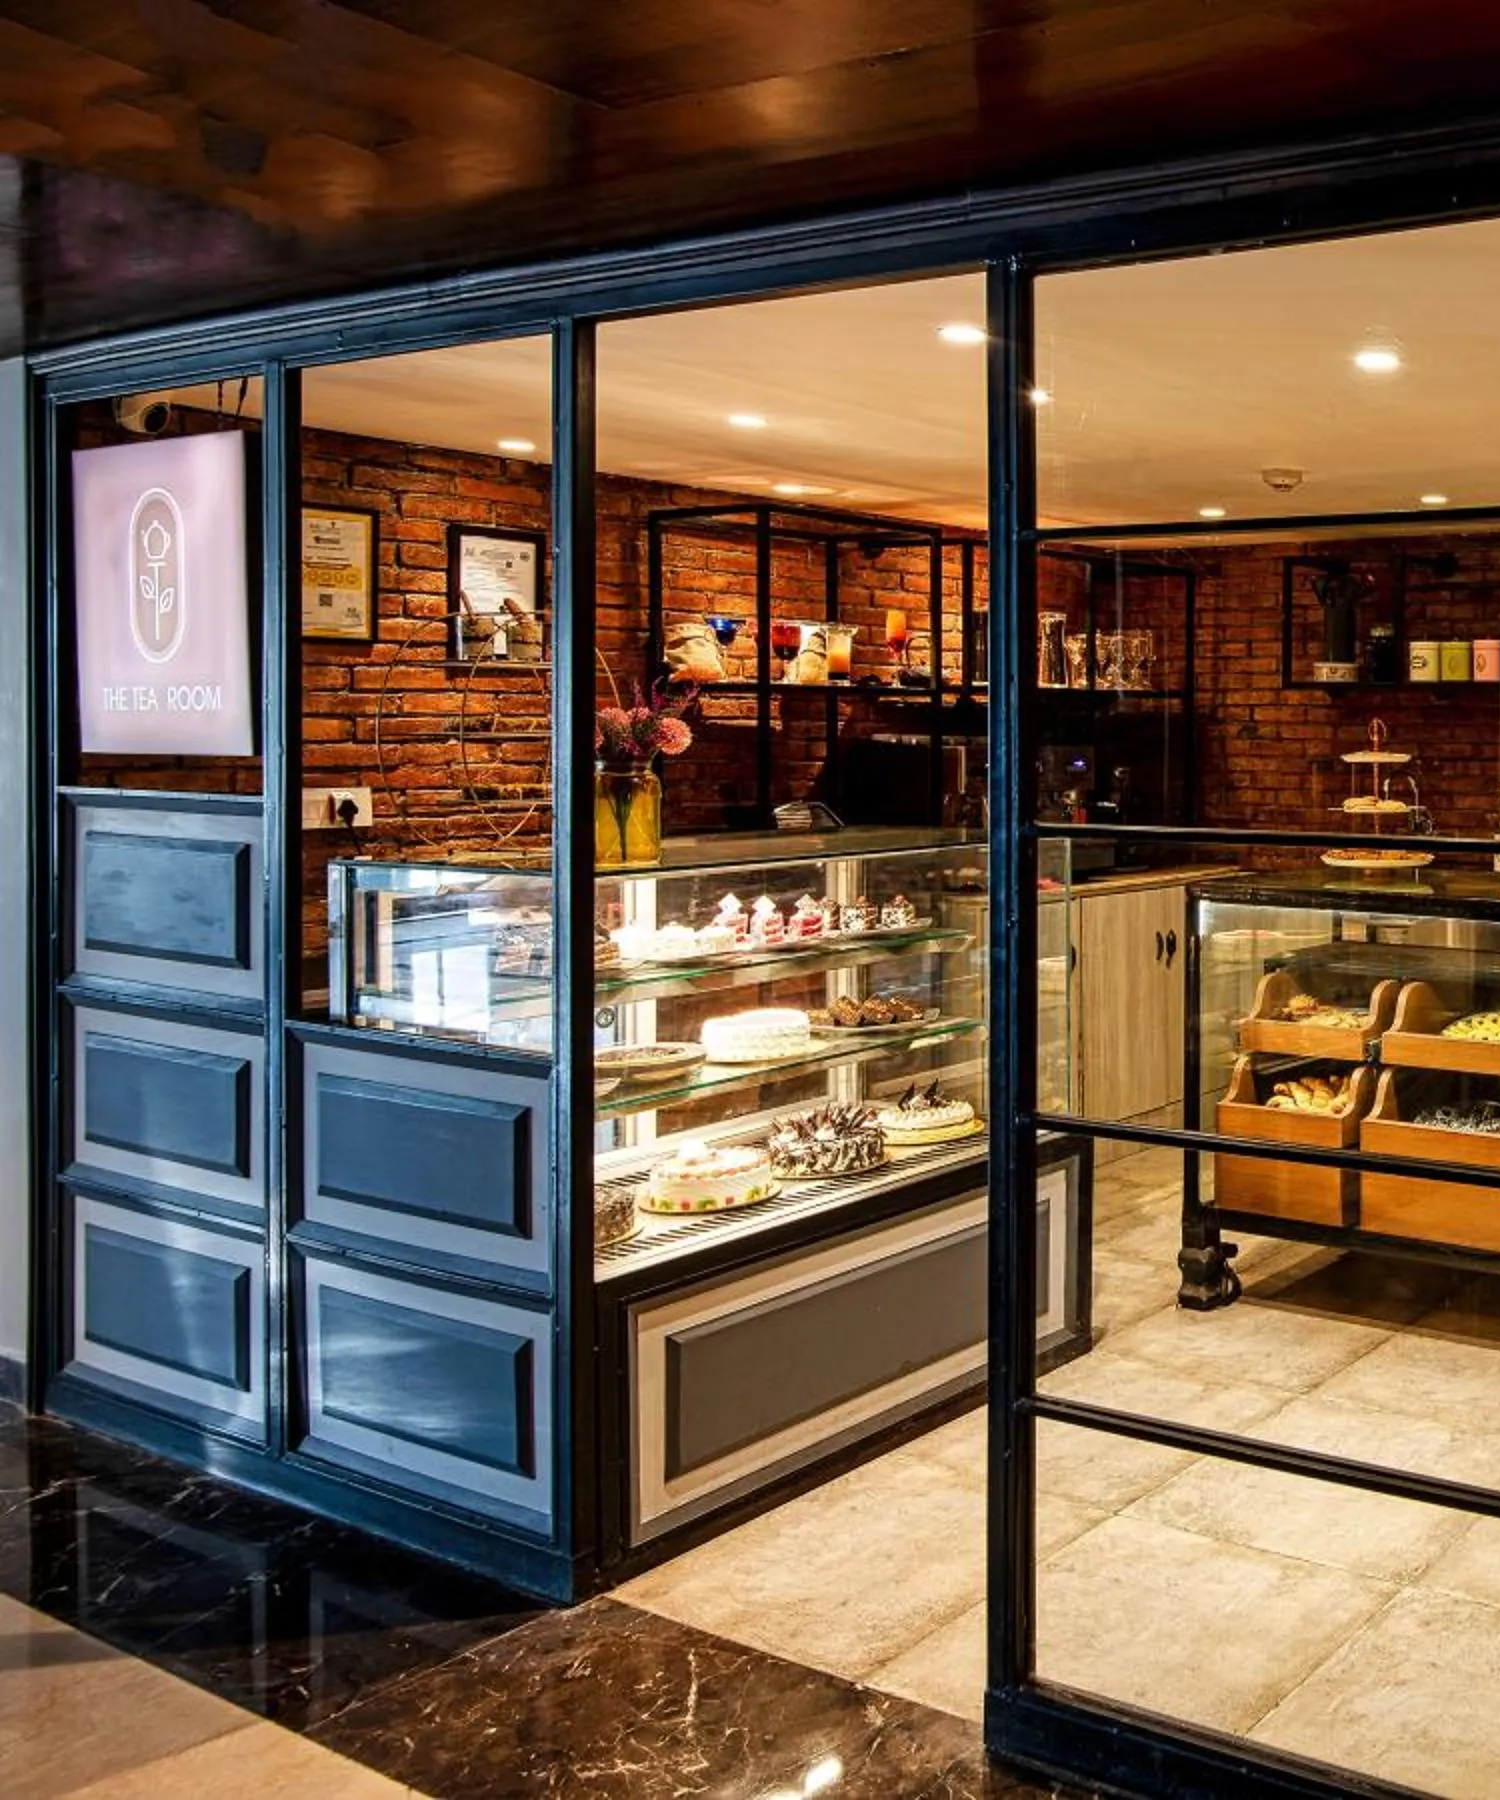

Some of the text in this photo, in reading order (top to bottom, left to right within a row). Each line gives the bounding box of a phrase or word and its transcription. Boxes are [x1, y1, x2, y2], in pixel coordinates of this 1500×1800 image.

[102, 685, 222, 711] THE TEA ROOM
